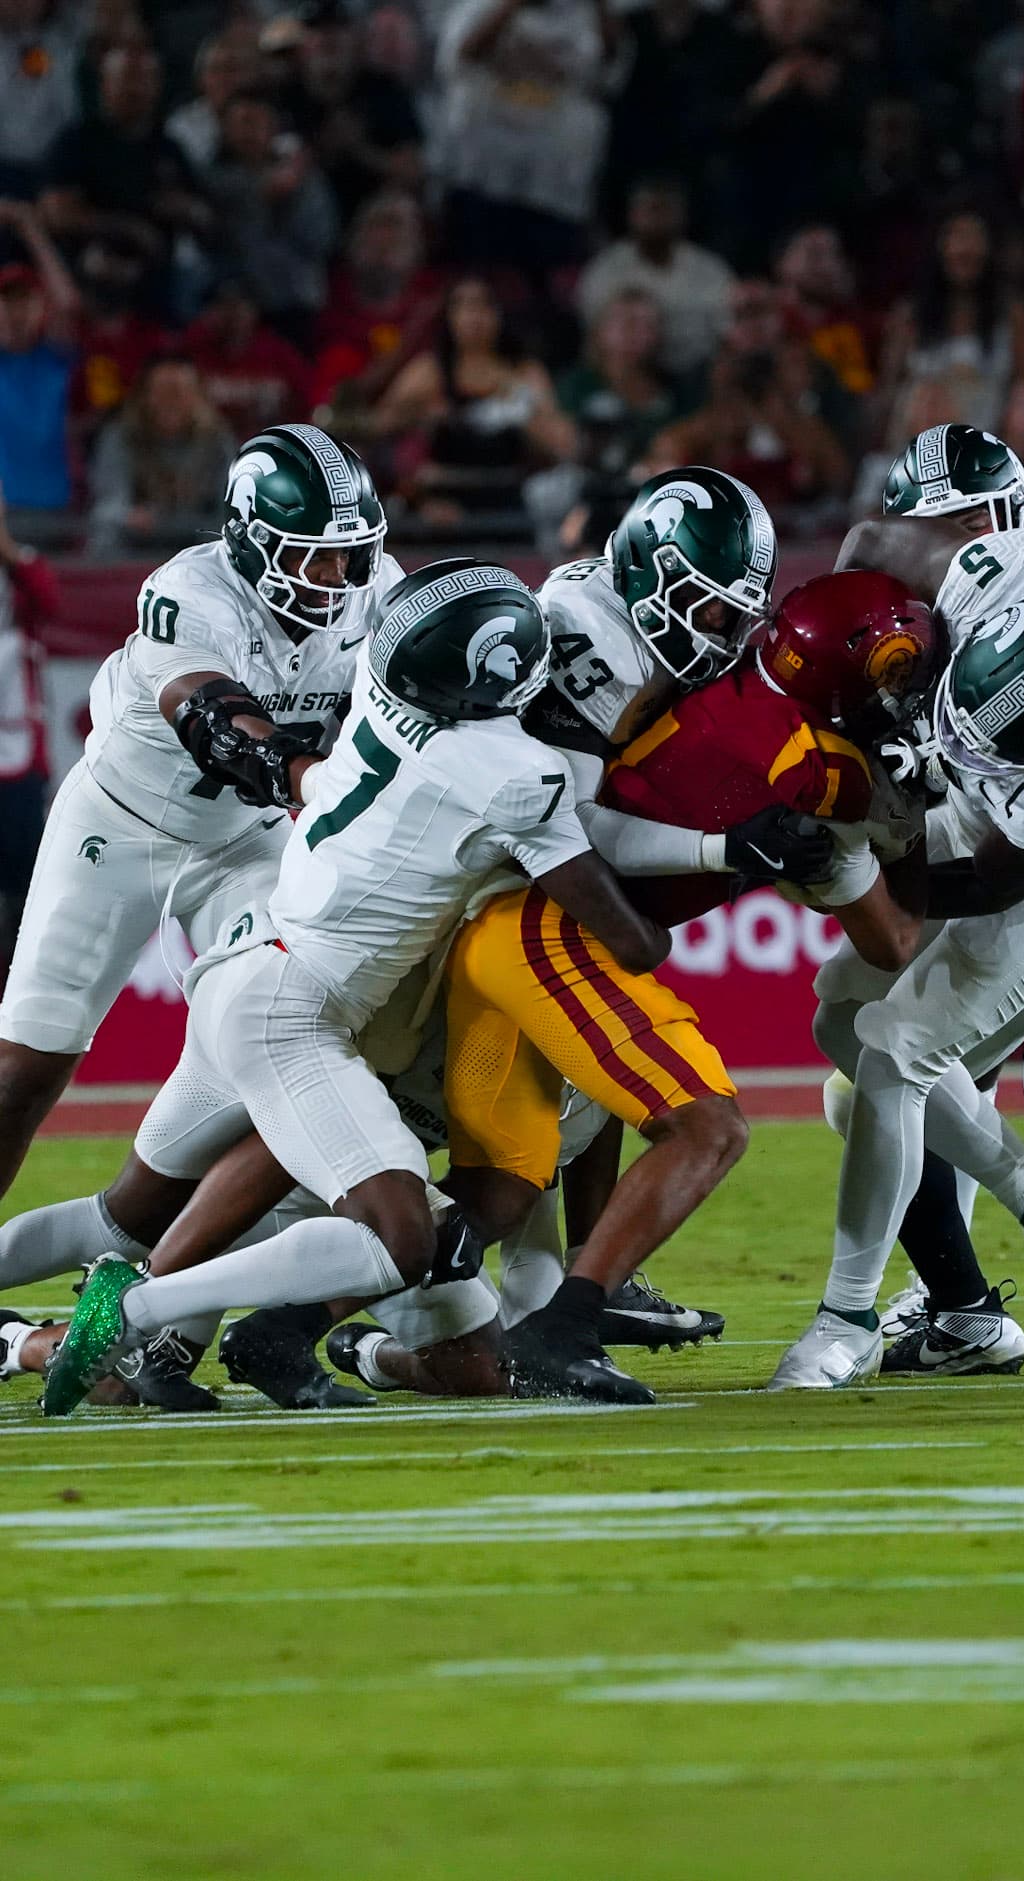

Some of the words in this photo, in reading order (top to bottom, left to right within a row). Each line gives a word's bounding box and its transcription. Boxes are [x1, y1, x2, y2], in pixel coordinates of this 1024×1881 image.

[141, 588, 180, 644] 10
[551, 633, 614, 701] 43
[305, 716, 401, 852] 7
[541, 773, 565, 823] 7
